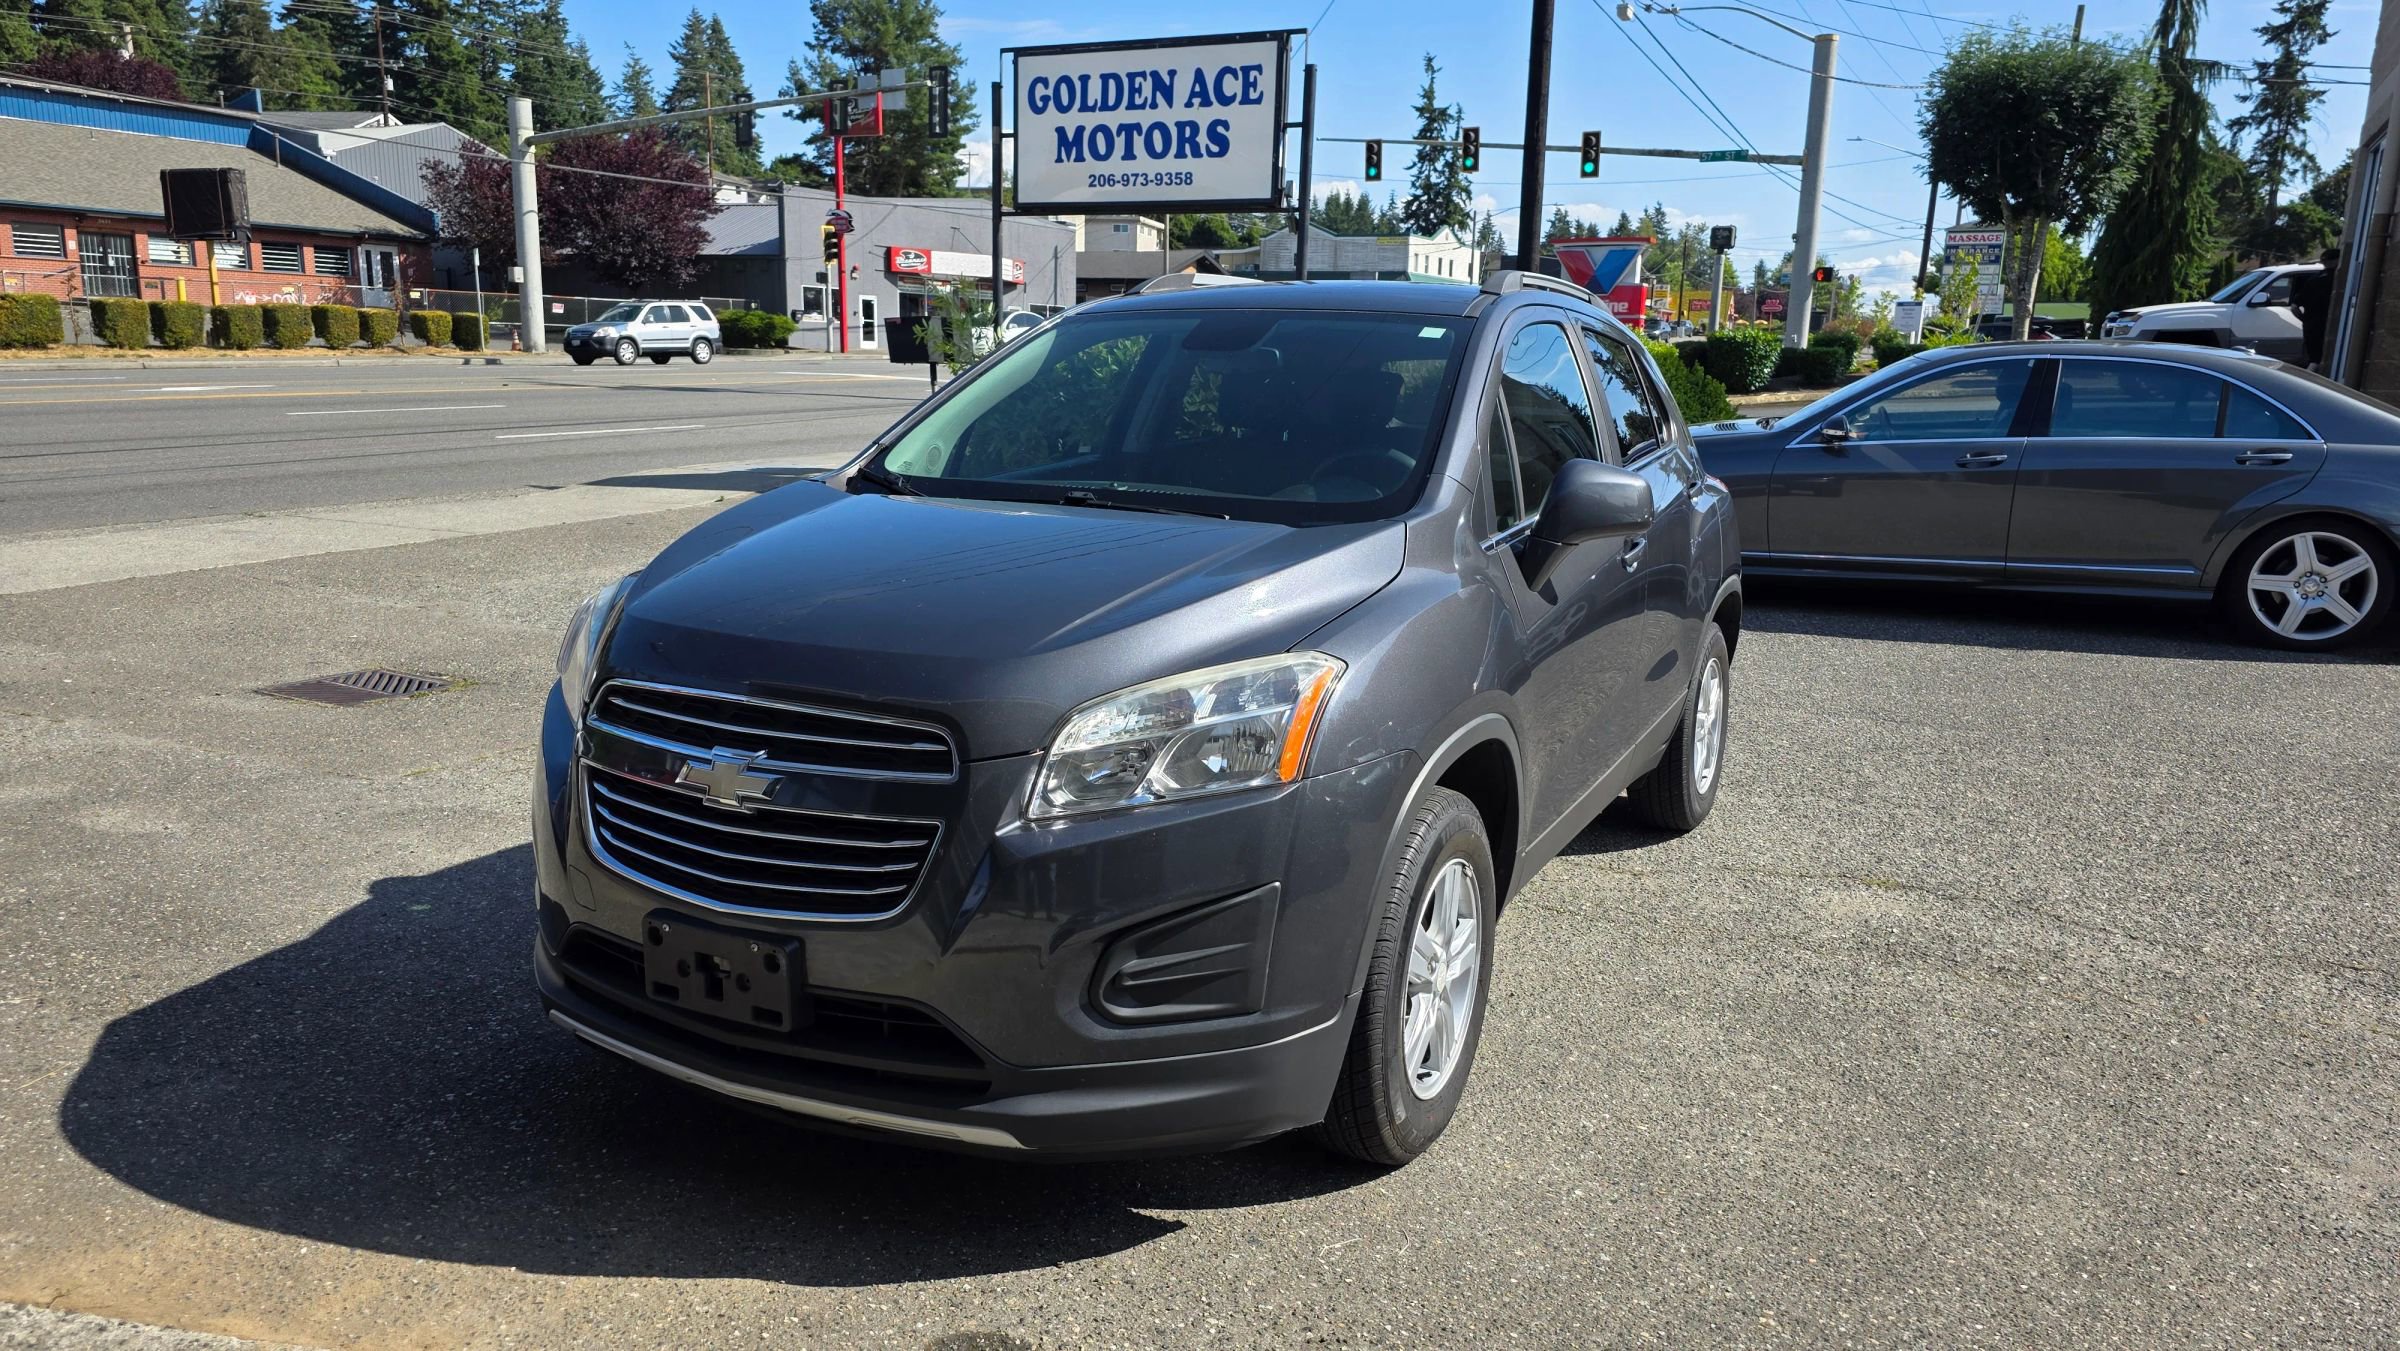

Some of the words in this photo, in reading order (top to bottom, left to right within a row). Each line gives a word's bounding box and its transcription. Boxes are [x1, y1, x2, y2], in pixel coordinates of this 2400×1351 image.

[1027, 69, 1178, 115] GOLDEN
[1184, 64, 1264, 108] ACE
[1055, 119, 1230, 163] MOTORS
[1088, 172, 1193, 187] 206-973-9358
[1948, 234, 2002, 242] MASSAGE
